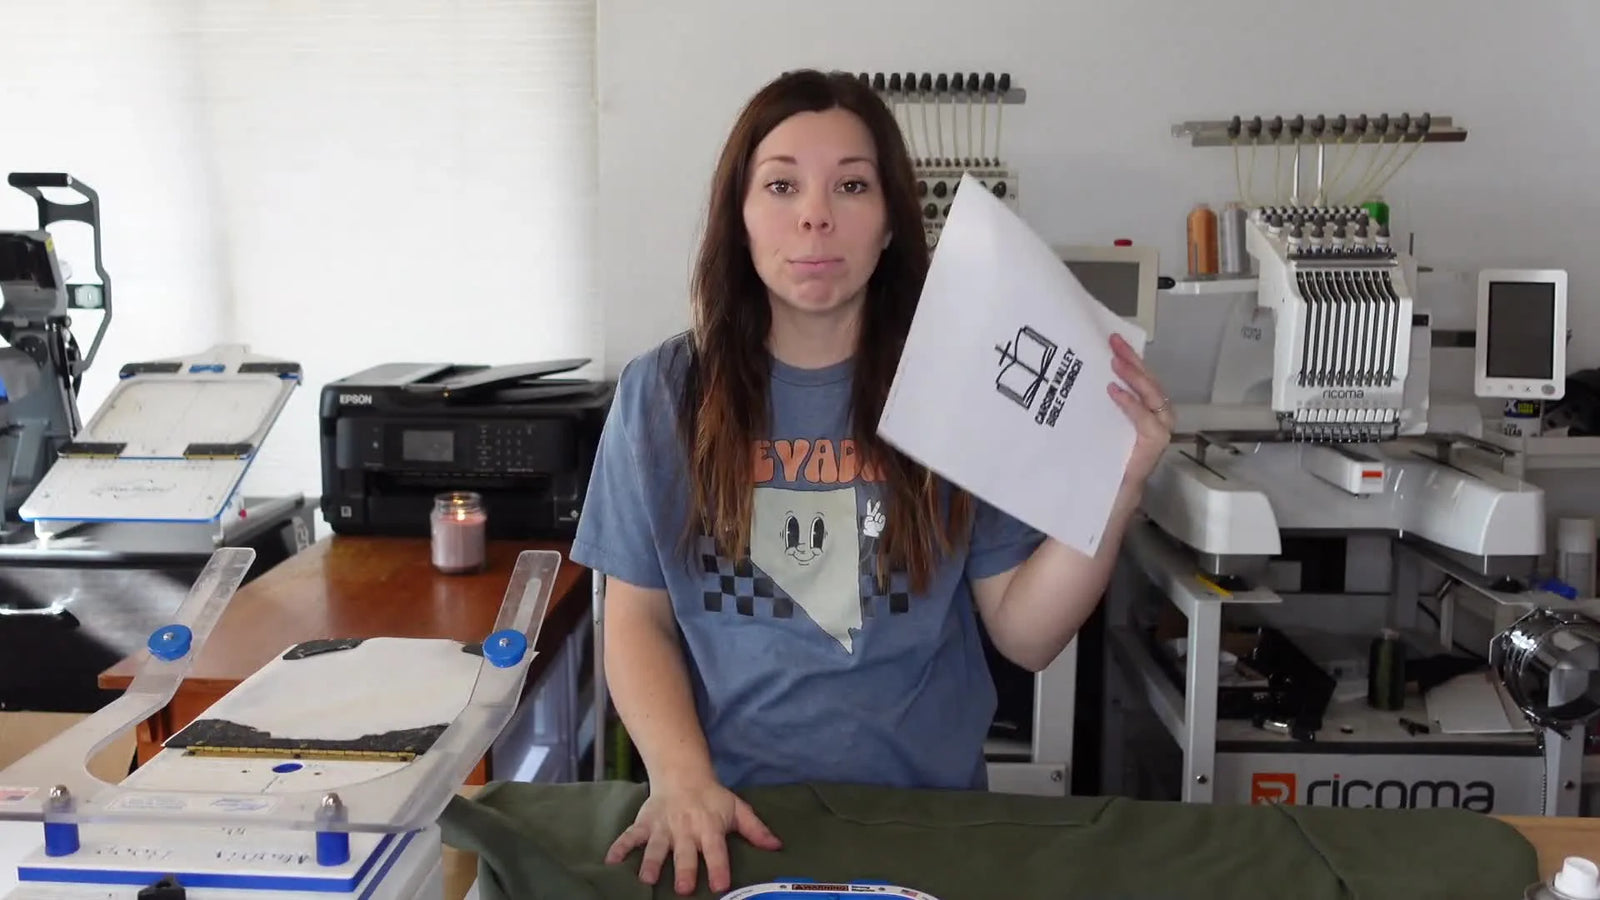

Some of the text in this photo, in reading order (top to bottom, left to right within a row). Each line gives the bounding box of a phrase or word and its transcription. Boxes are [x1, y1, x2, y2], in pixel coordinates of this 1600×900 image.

[339, 394, 372, 404] EPSON
[1035, 347, 1076, 425] CARSON VALLEY
[1046, 358, 1083, 428] BIBLE CHURCH
[1322, 389, 1364, 399] ricoma
[1307, 773, 1494, 813] ricoma
